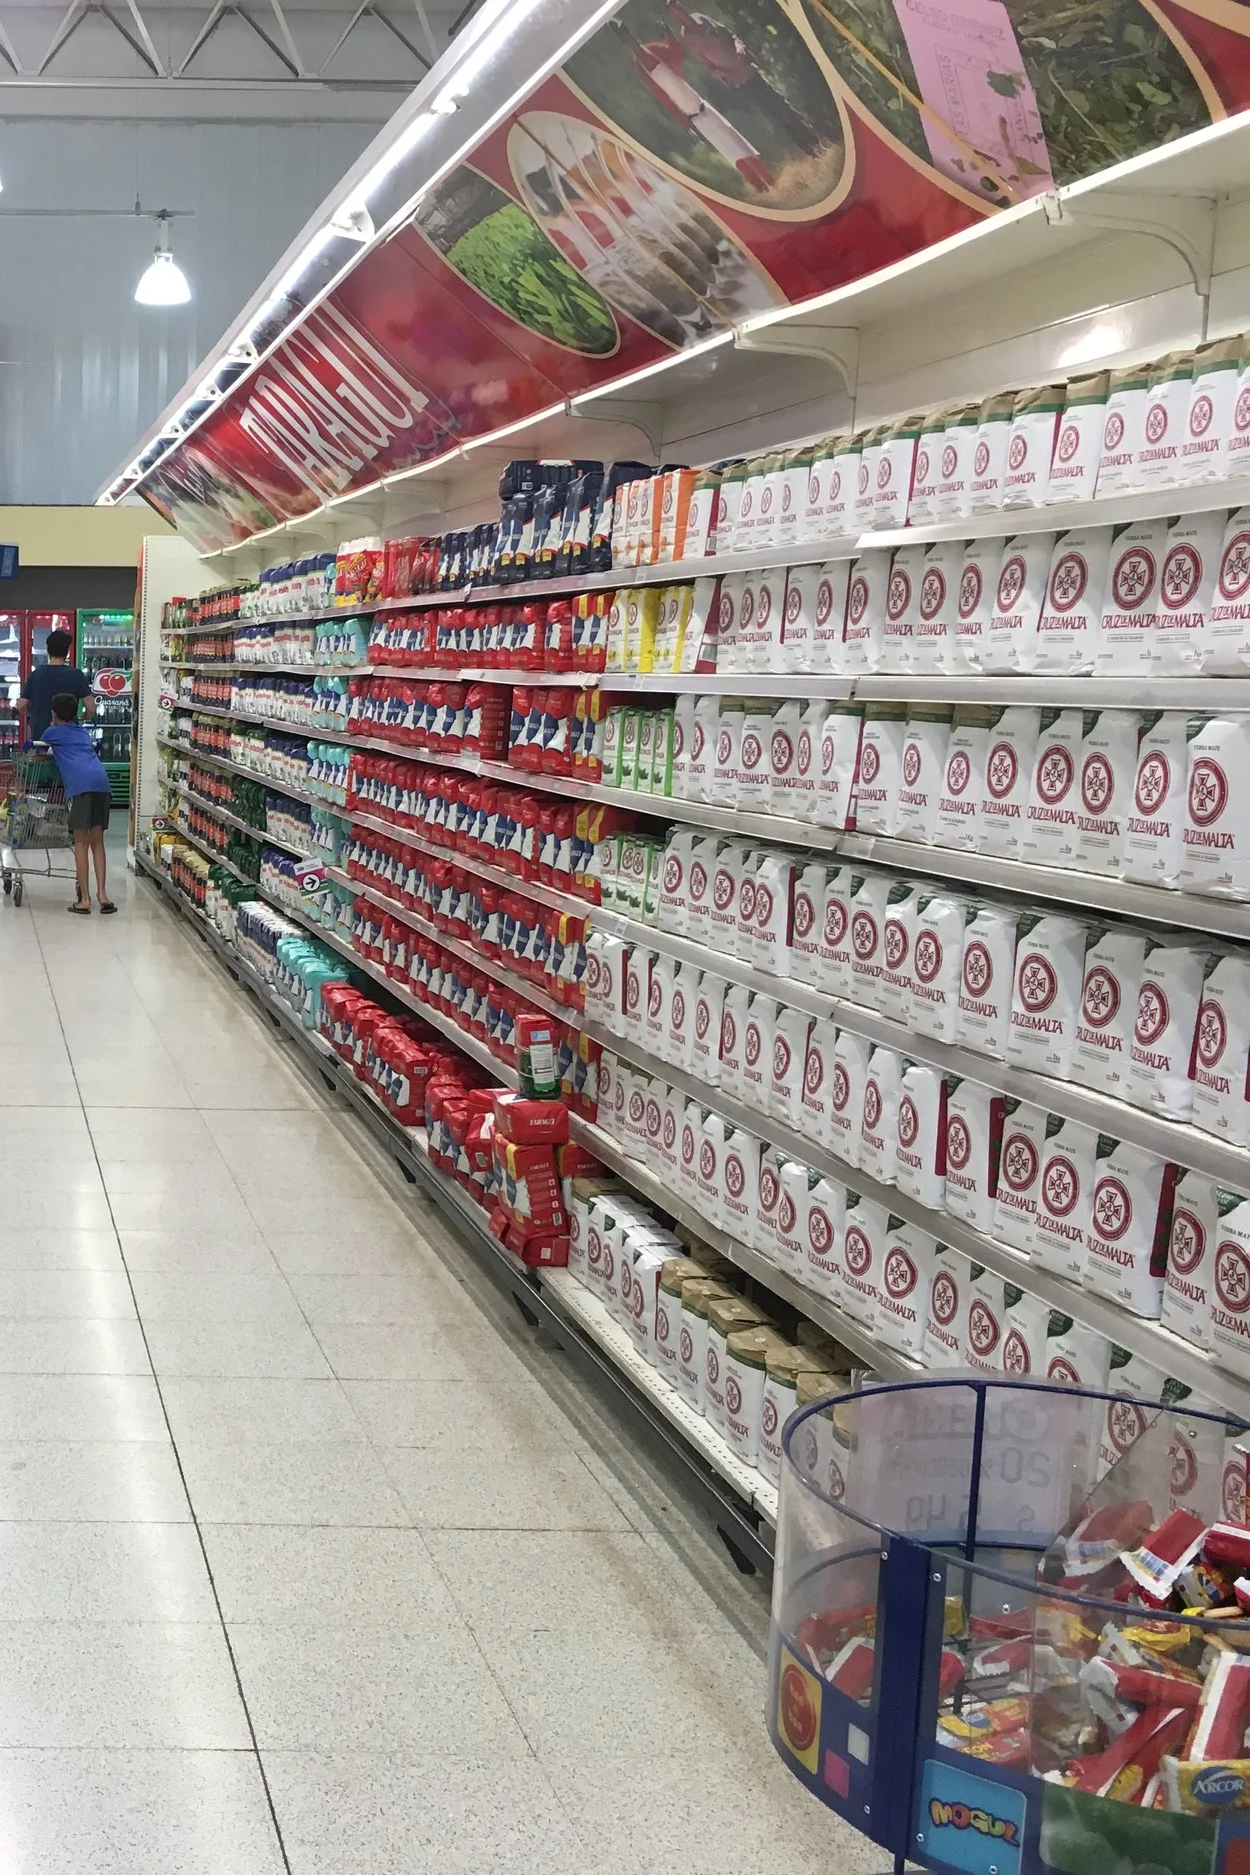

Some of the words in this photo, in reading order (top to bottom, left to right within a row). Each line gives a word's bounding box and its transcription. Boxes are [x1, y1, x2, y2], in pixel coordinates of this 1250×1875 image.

[1237, 1230, 1250, 1240] MAT
[1192, 1779, 1244, 1795] ARCOR
[929, 1797, 1020, 1847] MOGUL
